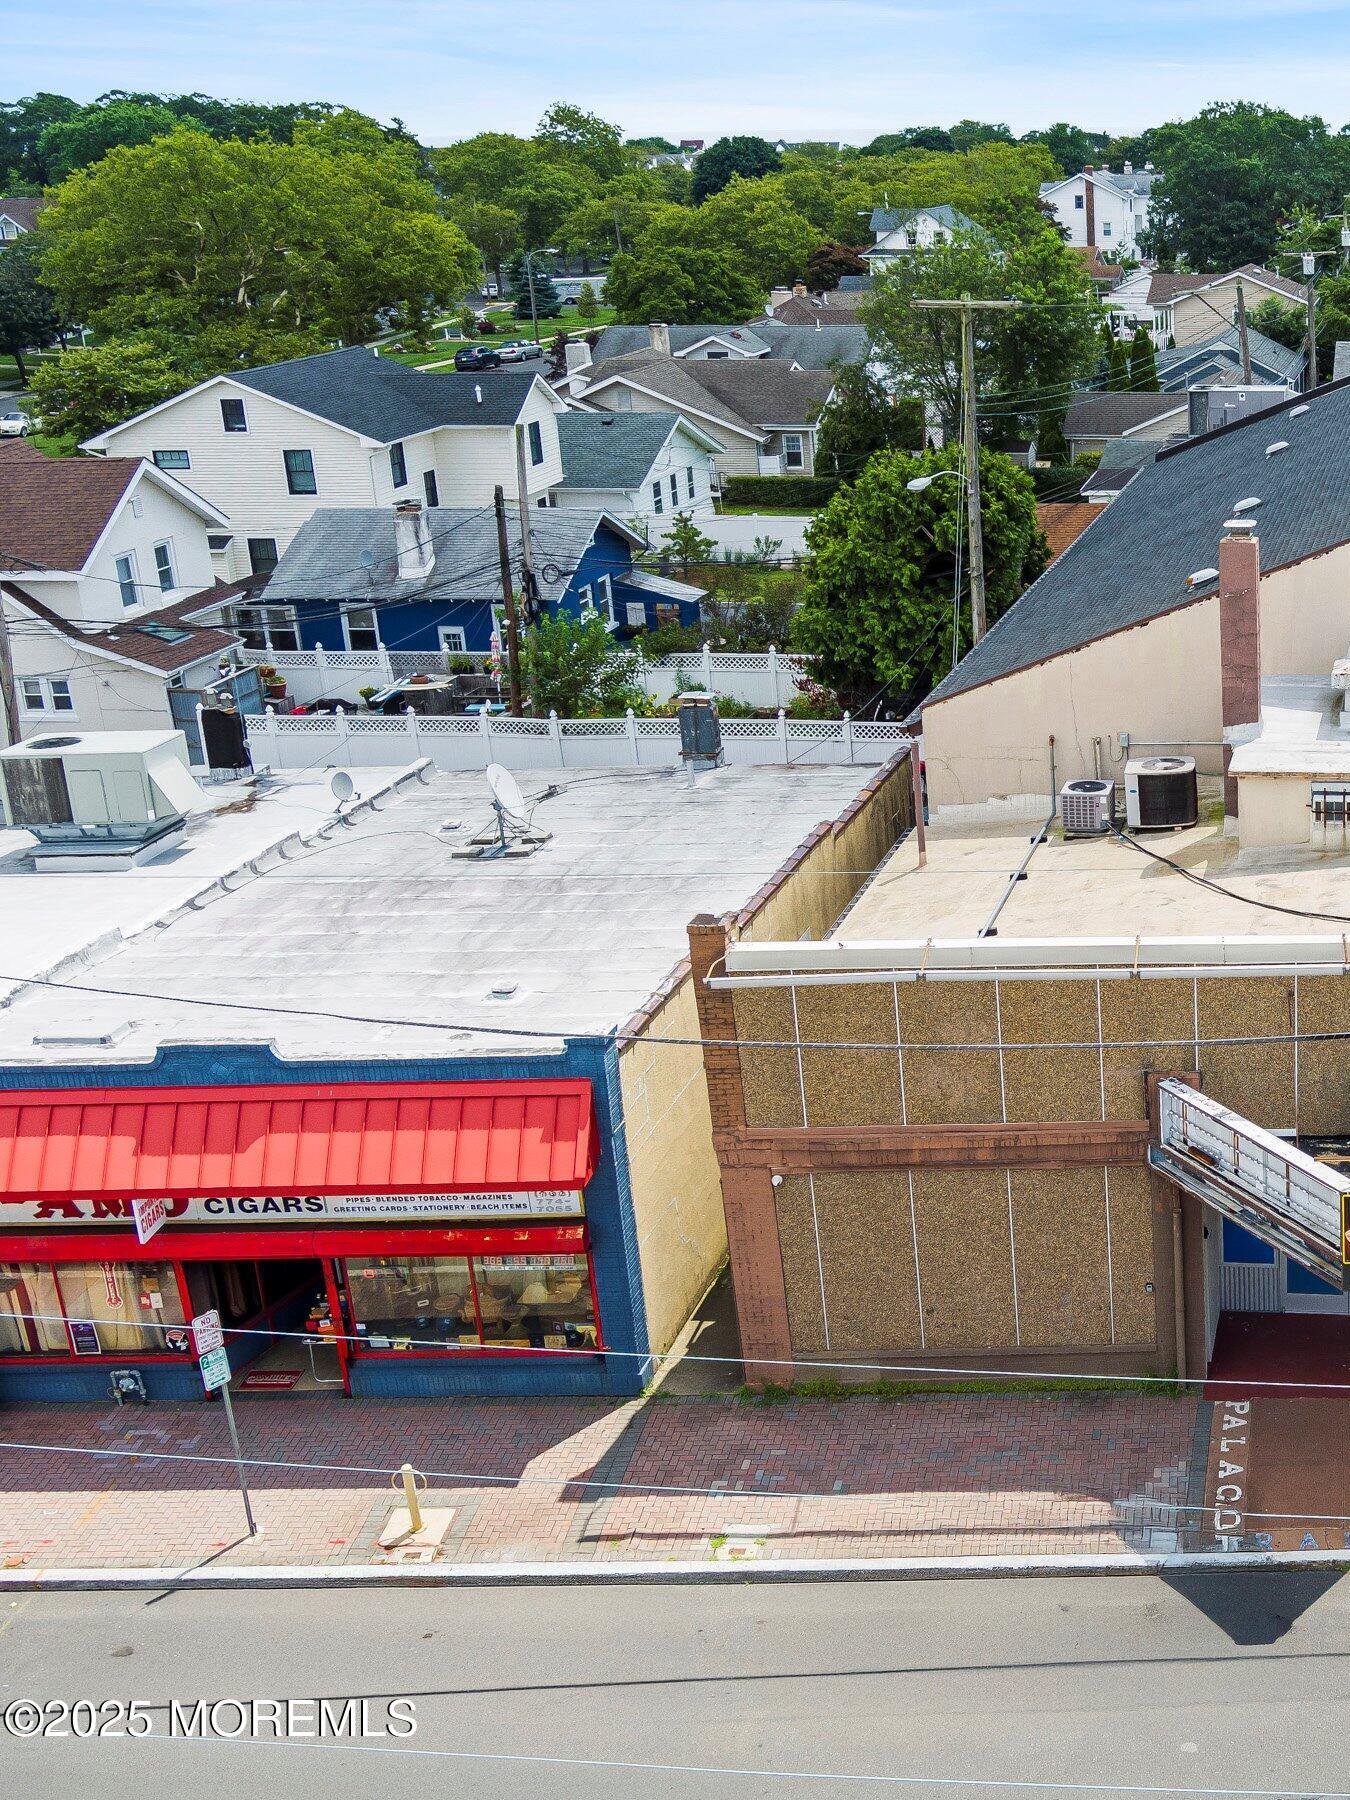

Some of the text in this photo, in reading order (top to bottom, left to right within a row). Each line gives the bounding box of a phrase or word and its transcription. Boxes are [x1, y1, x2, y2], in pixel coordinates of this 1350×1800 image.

[375, 1195, 416, 1203] BLENDED
[418, 1194, 459, 1202] TOBACCO
[204, 1196, 324, 1214] CIGARS
[412, 1204, 465, 1212] STATIONERY
[470, 1203, 500, 1211] BEACH
[501, 1202, 528, 1210] ITEMS
[140, 1200, 165, 1233] CIGARS
[200, 1317, 211, 1326] NO
